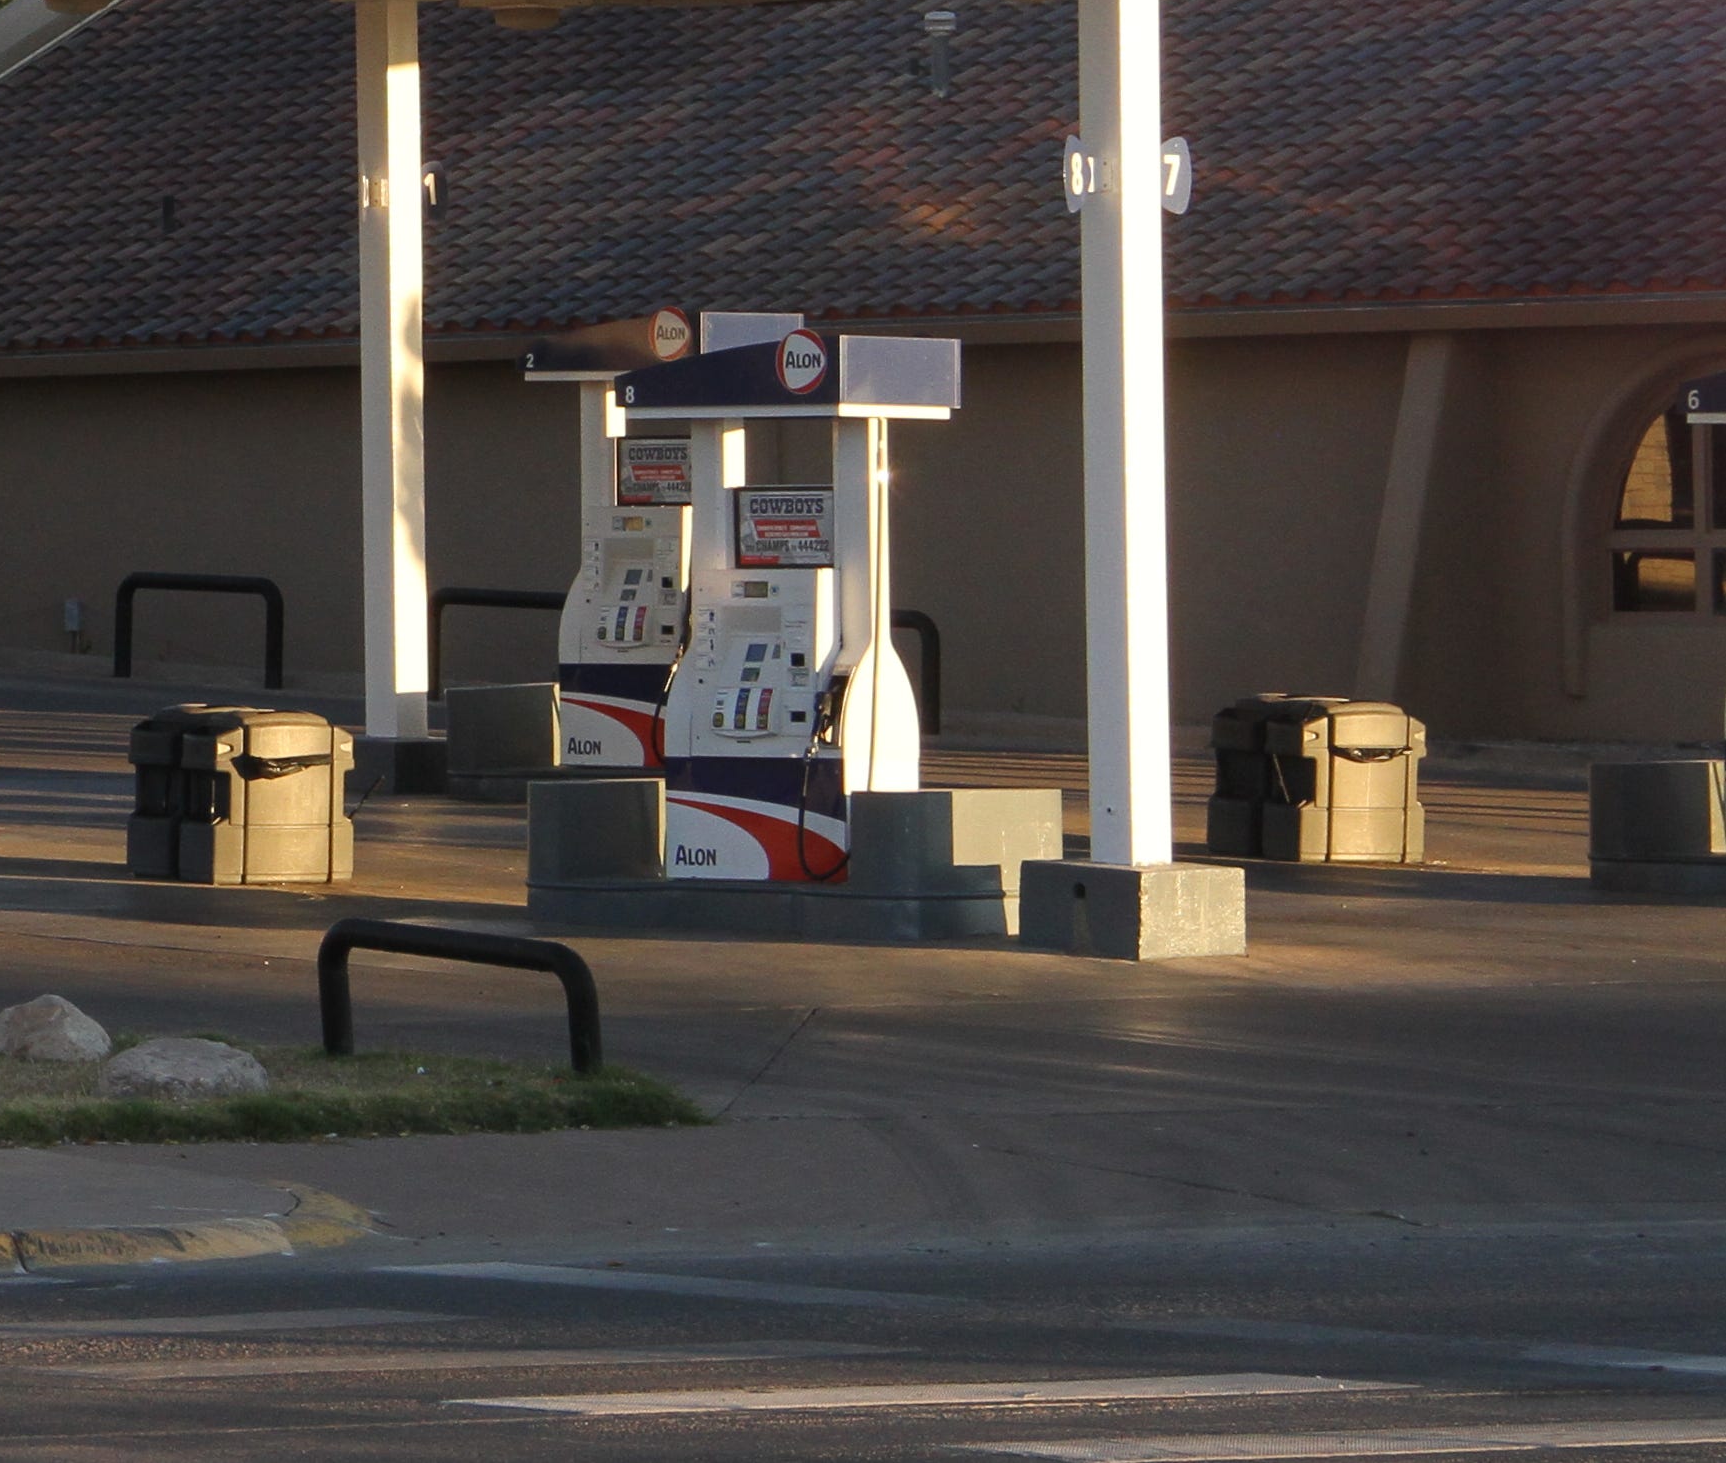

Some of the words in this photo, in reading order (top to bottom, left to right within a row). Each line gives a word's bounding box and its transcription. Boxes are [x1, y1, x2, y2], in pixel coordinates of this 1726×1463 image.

[1070, 151, 1085, 196] 8
[1162, 153, 1181, 196] 7
[422, 171, 438, 206] 1
[656, 324, 687, 340] ALON
[525, 353, 535, 369] 2
[785, 350, 822, 370] ALON
[625, 385, 635, 404] 8
[1688, 389, 1700, 410] 6
[629, 446, 688, 461] COWBOYS
[749, 497, 825, 515] COWBOYS
[567, 737, 602, 755] ALON
[674, 844, 717, 866] ALON
